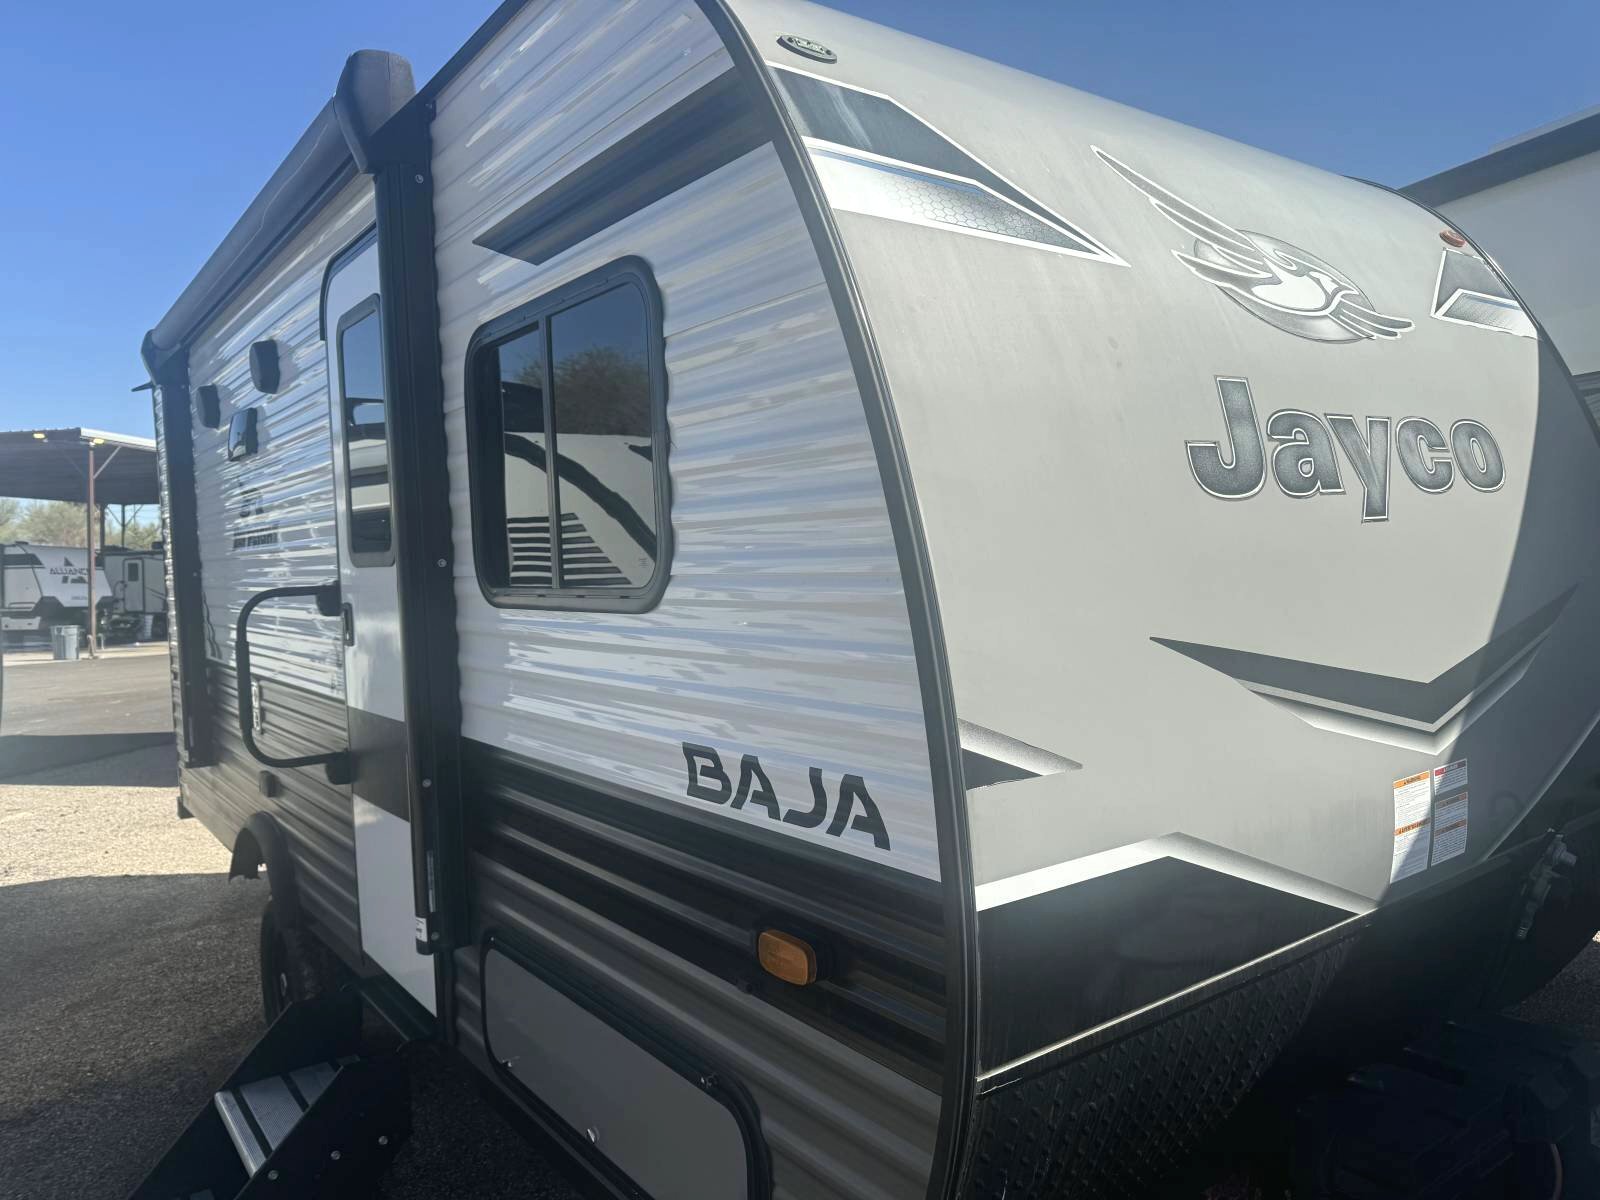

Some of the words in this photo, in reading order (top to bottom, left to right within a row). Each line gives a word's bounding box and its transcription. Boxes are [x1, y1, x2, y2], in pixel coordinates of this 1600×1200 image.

[1184, 375, 1506, 523] Jayco
[49, 567, 89, 576] ALLIANC
[682, 741, 891, 851] BAJA
